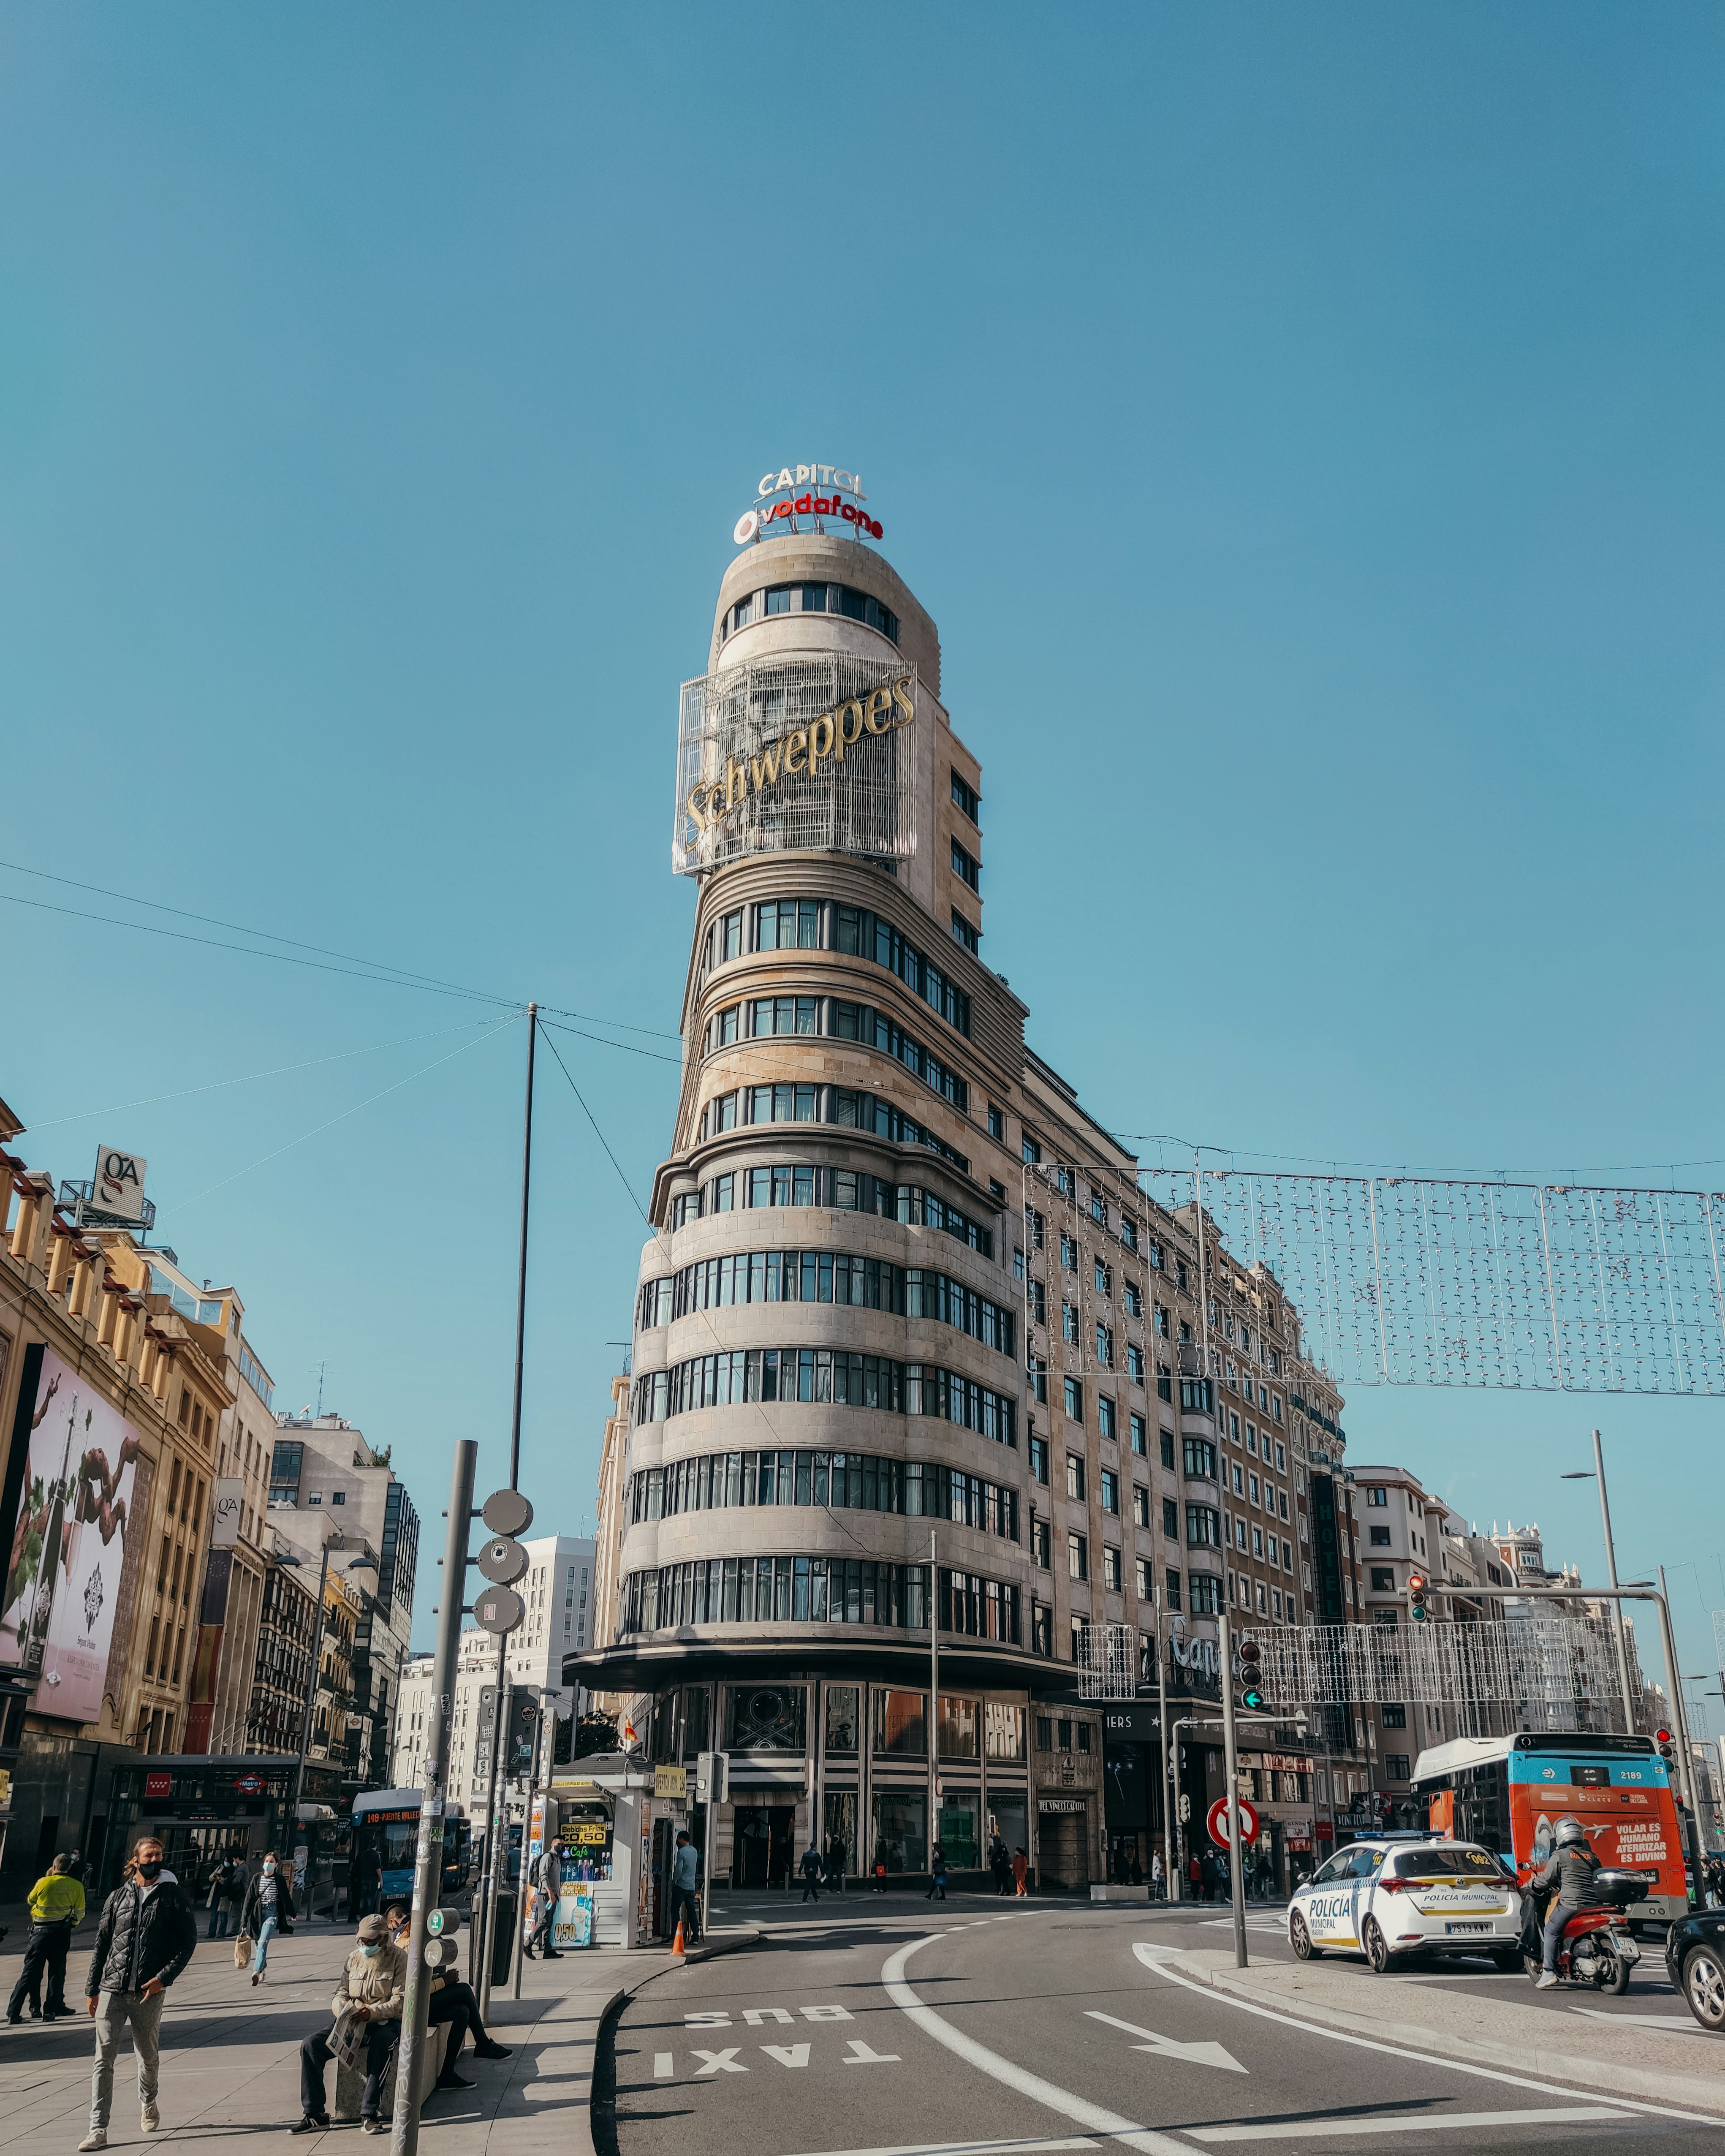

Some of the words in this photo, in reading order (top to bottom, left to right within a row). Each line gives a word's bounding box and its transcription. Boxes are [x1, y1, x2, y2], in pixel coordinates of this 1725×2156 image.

[758, 464, 868, 501] CAPITOL
[685, 676, 914, 853] Schweppes
[1320, 1504, 1338, 1616] HOTEL
[480, 1747, 489, 1756] 54
[656, 1769, 669, 1790] OFERTÓN
[1620, 1771, 1642, 1779] 2189
[594, 1781, 603, 1792] LOW
[604, 1789, 615, 1800] COST
[1039, 1801, 1049, 1811] TEL
[1049, 1801, 1066, 1811] VINCCI
[1067, 1802, 1086, 1811] CAPITOL
[367, 1813, 379, 1823] 148
[382, 1812, 400, 1821] PUENTE
[402, 1811, 421, 1820] VALLEC
[1616, 1824, 1646, 1834] VOLAR
[1649, 1823, 1661, 1832] ES
[1620, 1833, 1660, 1843] HUMANO
[570, 1845, 588, 1858] Café
[1616, 1842, 1666, 1854] ATERRIZAR
[1373, 1854, 1383, 1865] 112
[1471, 1854, 1491, 1865] 092
[1621, 1854, 1633, 1863] ES
[1635, 1851, 1666, 1862] DIVINO
[1423, 1893, 1458, 1901] POLICÍA
[1309, 1894, 1350, 1917] POLICÍA
[1310, 1918, 1336, 1929] MUNICIPAL
[1452, 1924, 1472, 1933] 7513
[554, 1923, 576, 1943] 0,50
[684, 2004, 856, 2029] BUS
[653, 2040, 902, 2078] TAXI
